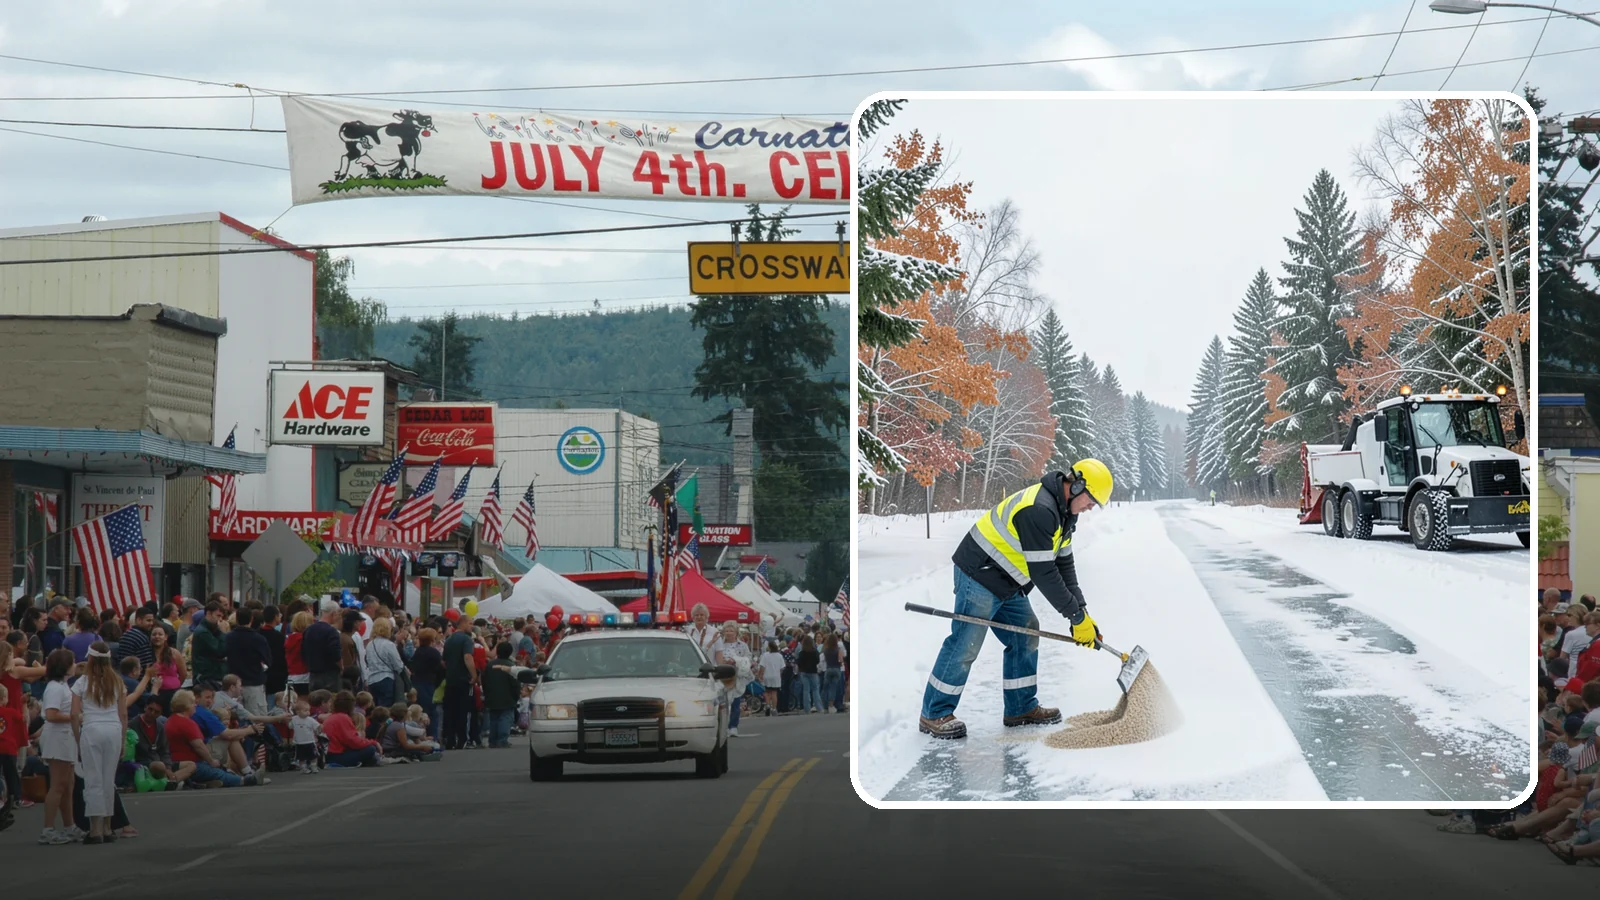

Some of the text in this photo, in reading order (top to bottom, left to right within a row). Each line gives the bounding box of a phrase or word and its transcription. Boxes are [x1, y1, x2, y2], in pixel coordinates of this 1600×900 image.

[695, 121, 850, 149] Carnat
[481, 141, 605, 193] JULY
[632, 150, 747, 198] 4th.
[697, 254, 850, 280] CROSSWA
[282, 380, 374, 420] ACE
[405, 409, 485, 422] CEDAR LOG
[283, 421, 371, 436] Hardware
[416, 428, 477, 447] Coca-Cola
[353, 467, 386, 479] Simpl
[96, 486, 124, 495] Vincent
[126, 486, 136, 495] de
[138, 486, 155, 495] Paul
[688, 526, 741, 535] CRNATION
[699, 535, 730, 543] GLASS
